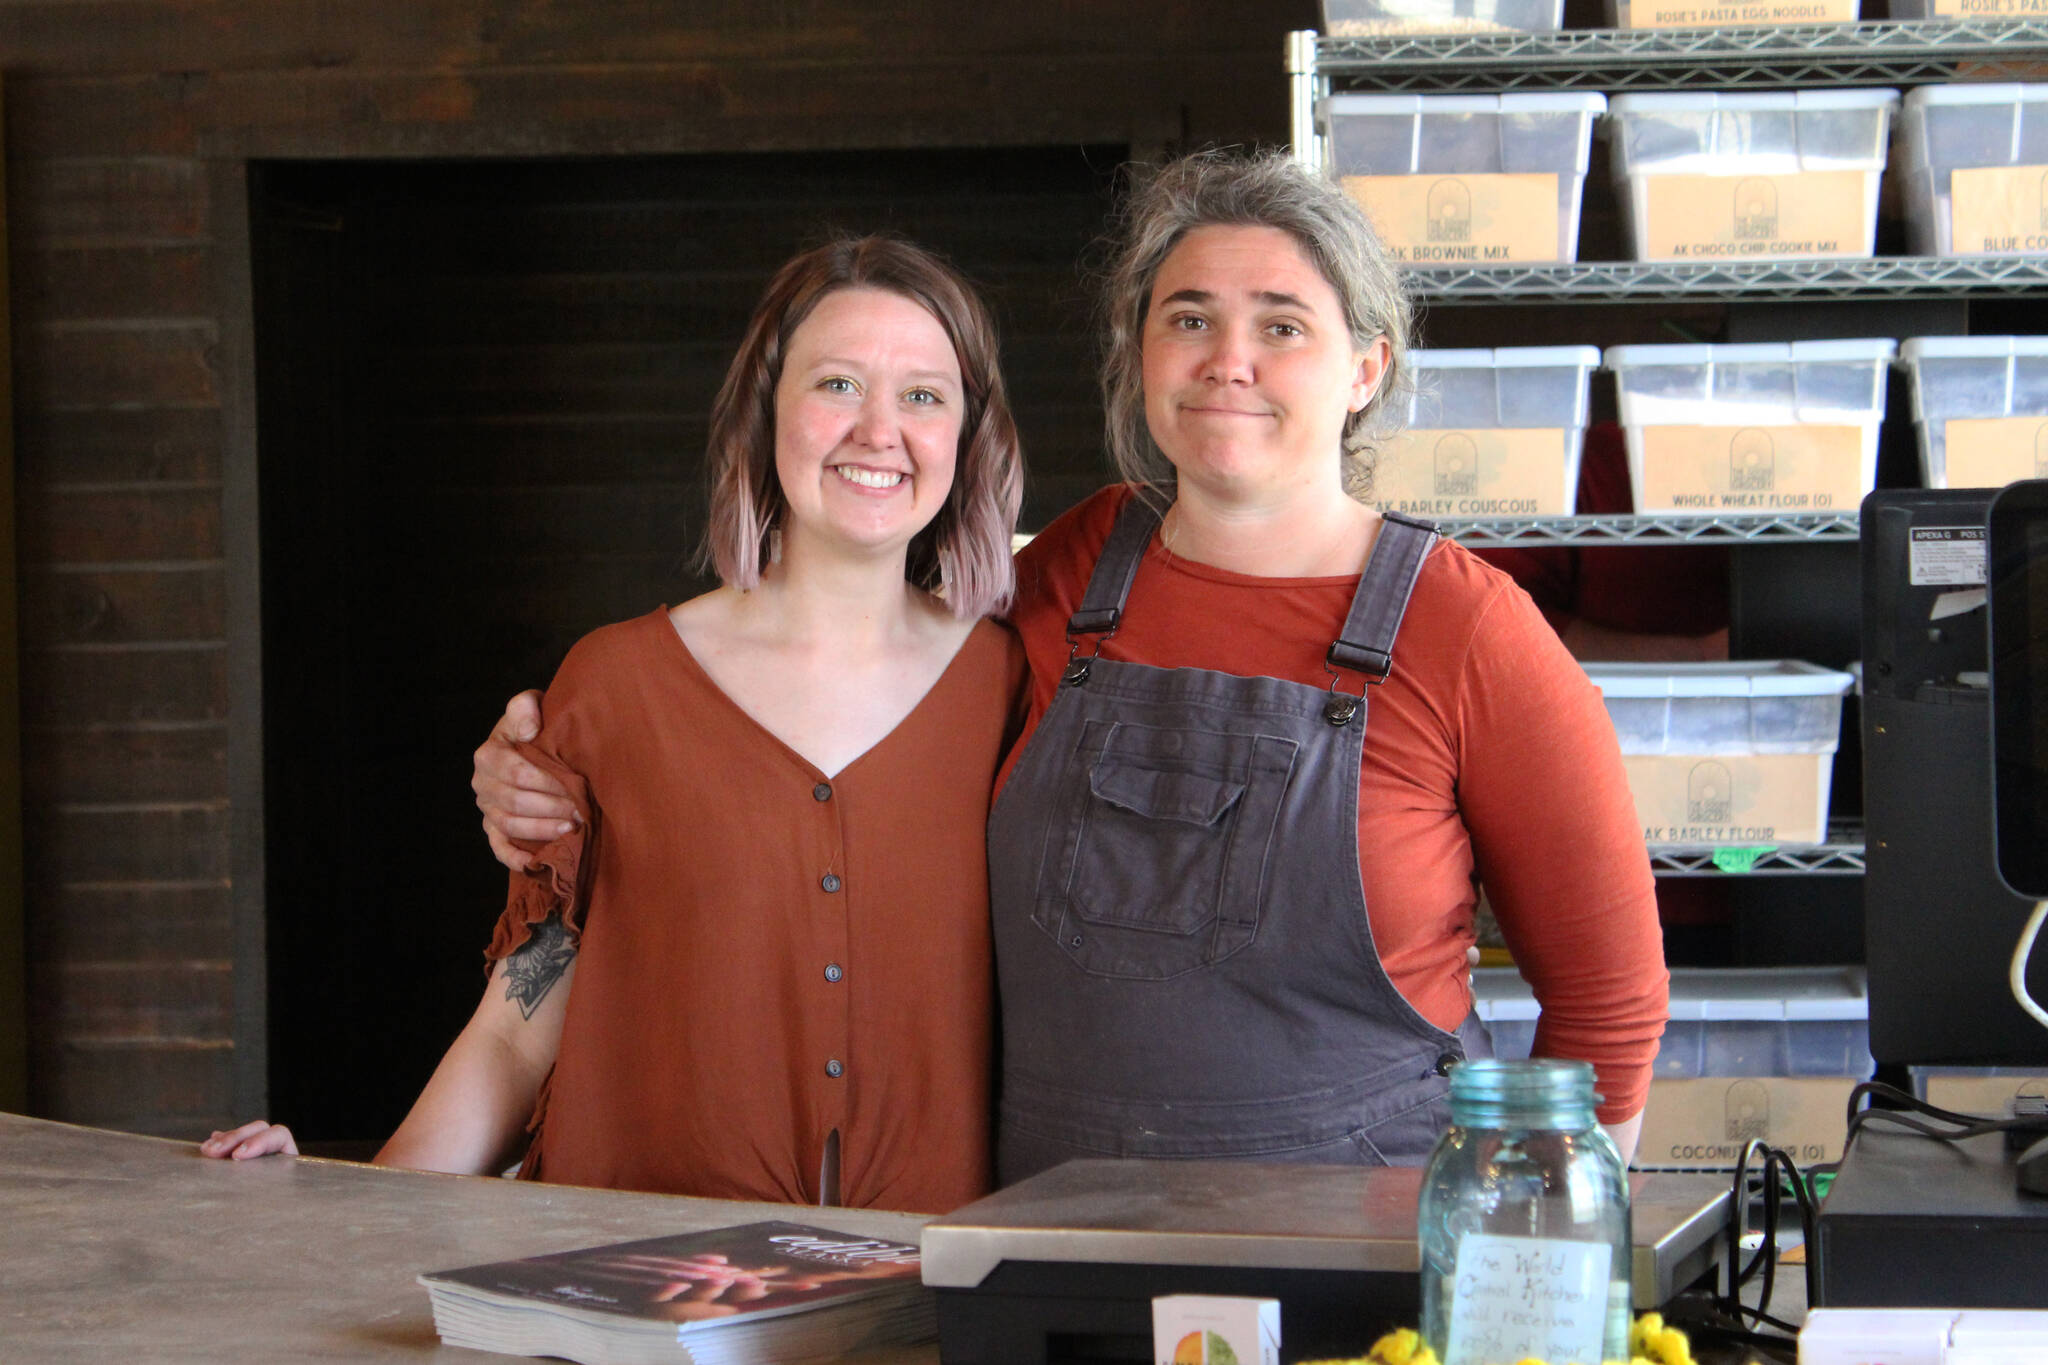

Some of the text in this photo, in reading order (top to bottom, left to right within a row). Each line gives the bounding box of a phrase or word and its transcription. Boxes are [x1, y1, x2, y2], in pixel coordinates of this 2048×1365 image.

[1656, 5, 1826, 23] ROSIE'S PASTA EGG NOODLES
[1673, 240, 1838, 256] AK CHOCO CHIP COOKIE MIX
[1984, 235, 2019, 251] BLUE
[1413, 246, 1478, 260] BROWNIE
[1484, 246, 1510, 259] MIX
[1376, 499, 1538, 513] AK BARLEY COUSCOUS
[1672, 494, 1715, 507] WHOLE
[1721, 494, 1764, 507] WHEAT
[1769, 494, 1809, 507] FLOUR
[1644, 827, 1775, 841] AK BARLEY FLOUR
[1670, 1145, 1744, 1159] COCONUT
[1515, 1251, 1567, 1276] World
